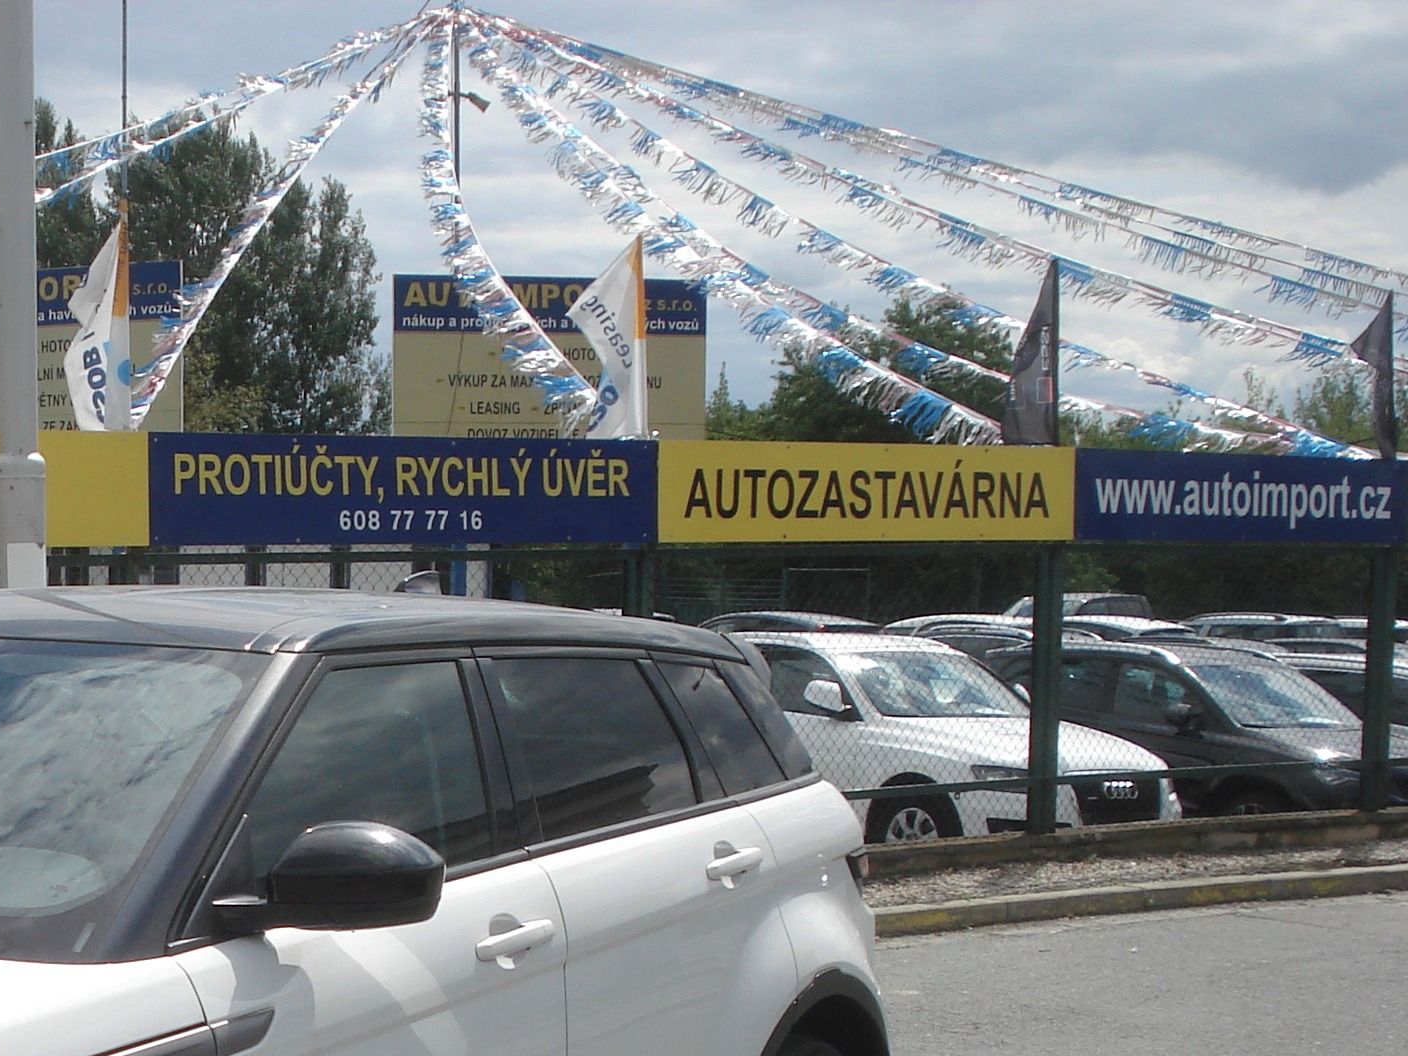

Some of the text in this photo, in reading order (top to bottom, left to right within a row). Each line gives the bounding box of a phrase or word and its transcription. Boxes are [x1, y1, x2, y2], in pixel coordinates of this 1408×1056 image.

[133, 282, 172, 296] s.r.o.
[141, 301, 172, 315] vozů
[657, 299, 697, 311] s.r.o.
[402, 314, 445, 329] nákup
[449, 318, 456, 328] a
[668, 318, 700, 330] vozů
[491, 374, 507, 388] ZA
[470, 401, 521, 415] LEASING
[173, 444, 631, 503] PROTIÚČTY, RYCHLÝ ÚVĚR
[684, 459, 1050, 519] AUTOZASTAVÁRNA
[1095, 470, 1392, 529] www.autoimport.cz
[339, 509, 482, 532] 608 77 77 16
